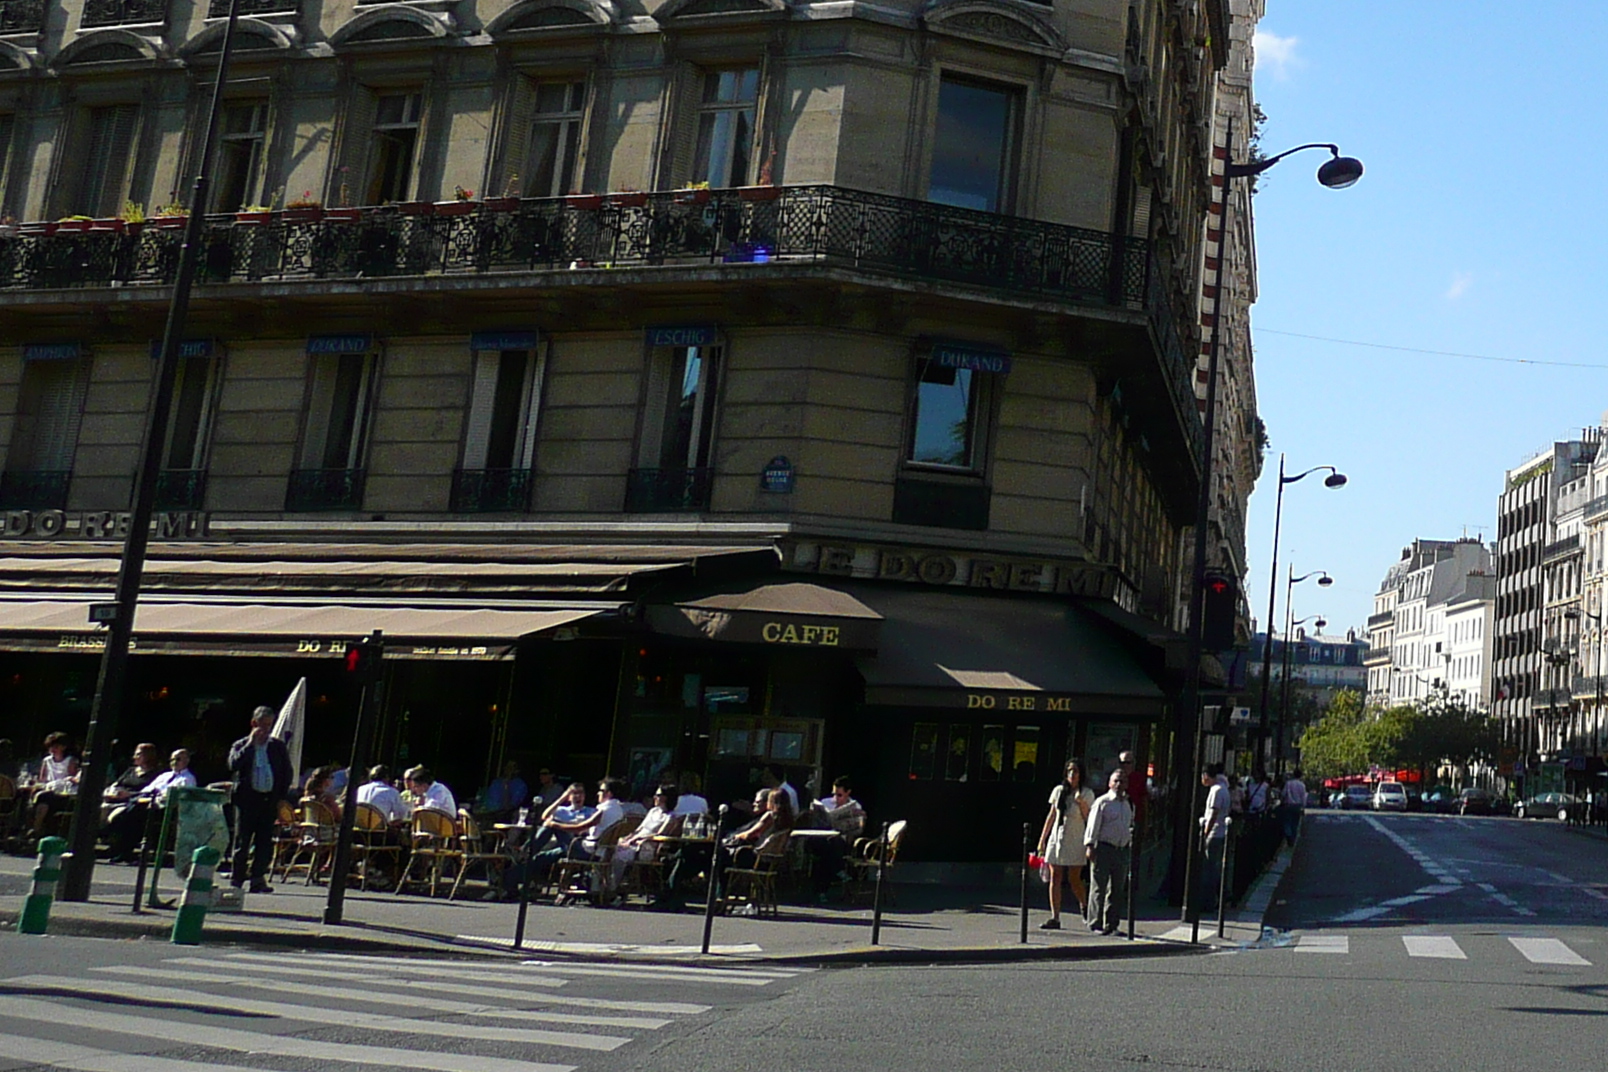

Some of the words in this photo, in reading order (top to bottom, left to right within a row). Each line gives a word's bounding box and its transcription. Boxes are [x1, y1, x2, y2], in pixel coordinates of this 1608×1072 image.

[311, 337, 364, 352] DURAND
[654, 330, 704, 345] ESCHIG
[939, 352, 1004, 373] DURAND
[3, 510, 65, 538] DO
[154, 512, 210, 540] MI
[781, 542, 855, 576] LE
[879, 547, 956, 585] DO
[971, 557, 1040, 592] RE
[1055, 565, 1115, 599] MI
[762, 622, 840, 646] CAFE
[296, 640, 320, 653] DO
[966, 695, 997, 710] DO
[1007, 696, 1036, 711] RE
[1046, 697, 1073, 712] MI
